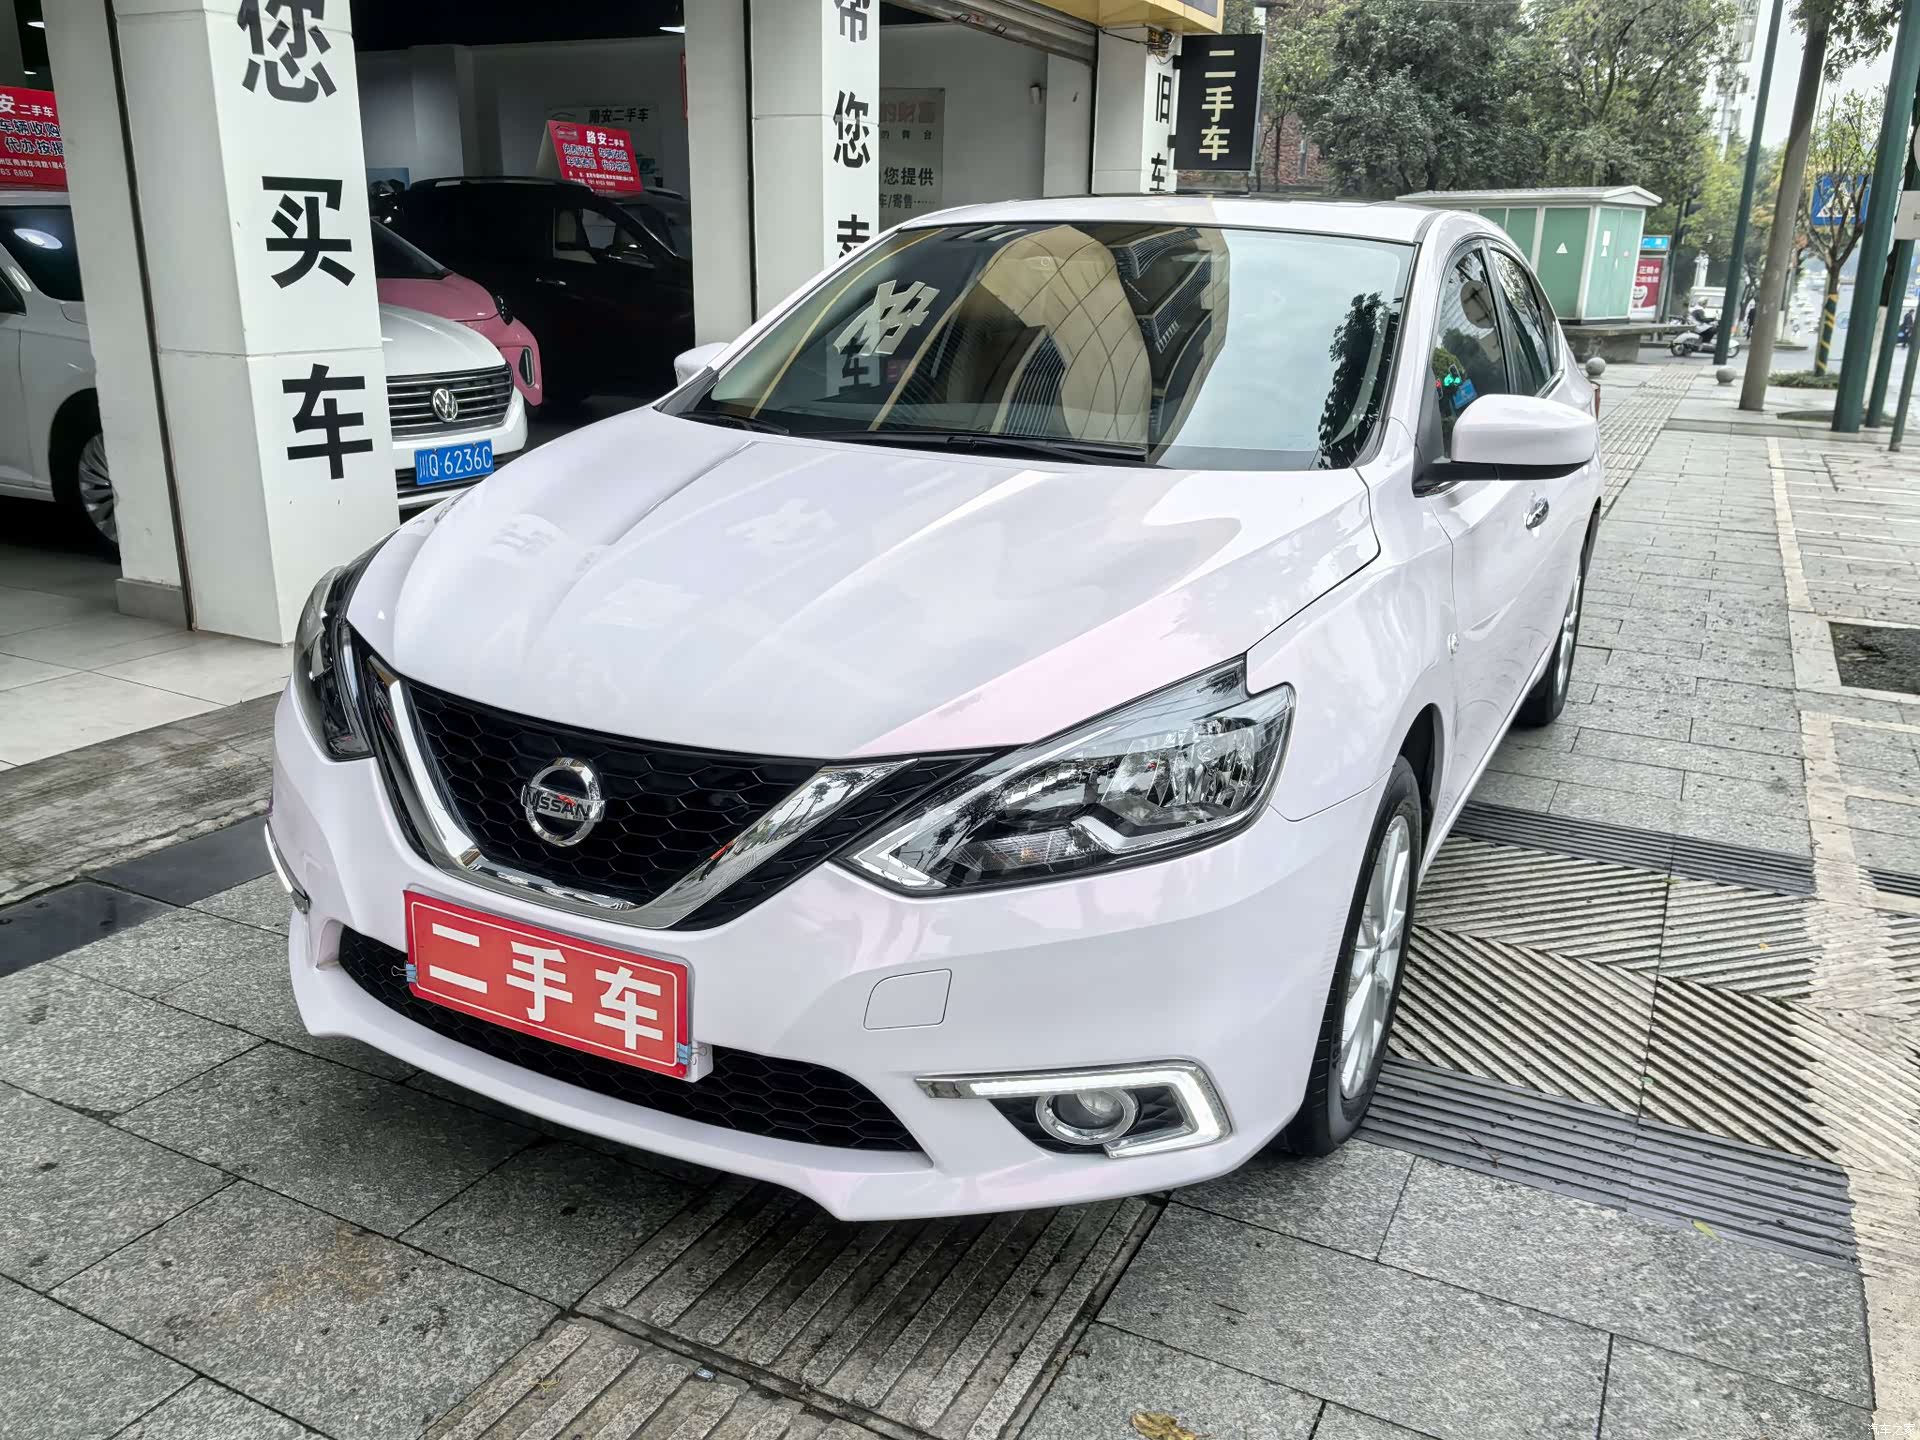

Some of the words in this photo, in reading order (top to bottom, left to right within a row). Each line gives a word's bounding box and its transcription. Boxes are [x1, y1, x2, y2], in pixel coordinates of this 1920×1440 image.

[19, 104, 55, 118] 二手车
[1199, 49, 1237, 161] 二手车
[884, 166, 934, 186] 您提供
[525, 786, 592, 820] NISSAN
[429, 922, 664, 1050] 二手车
